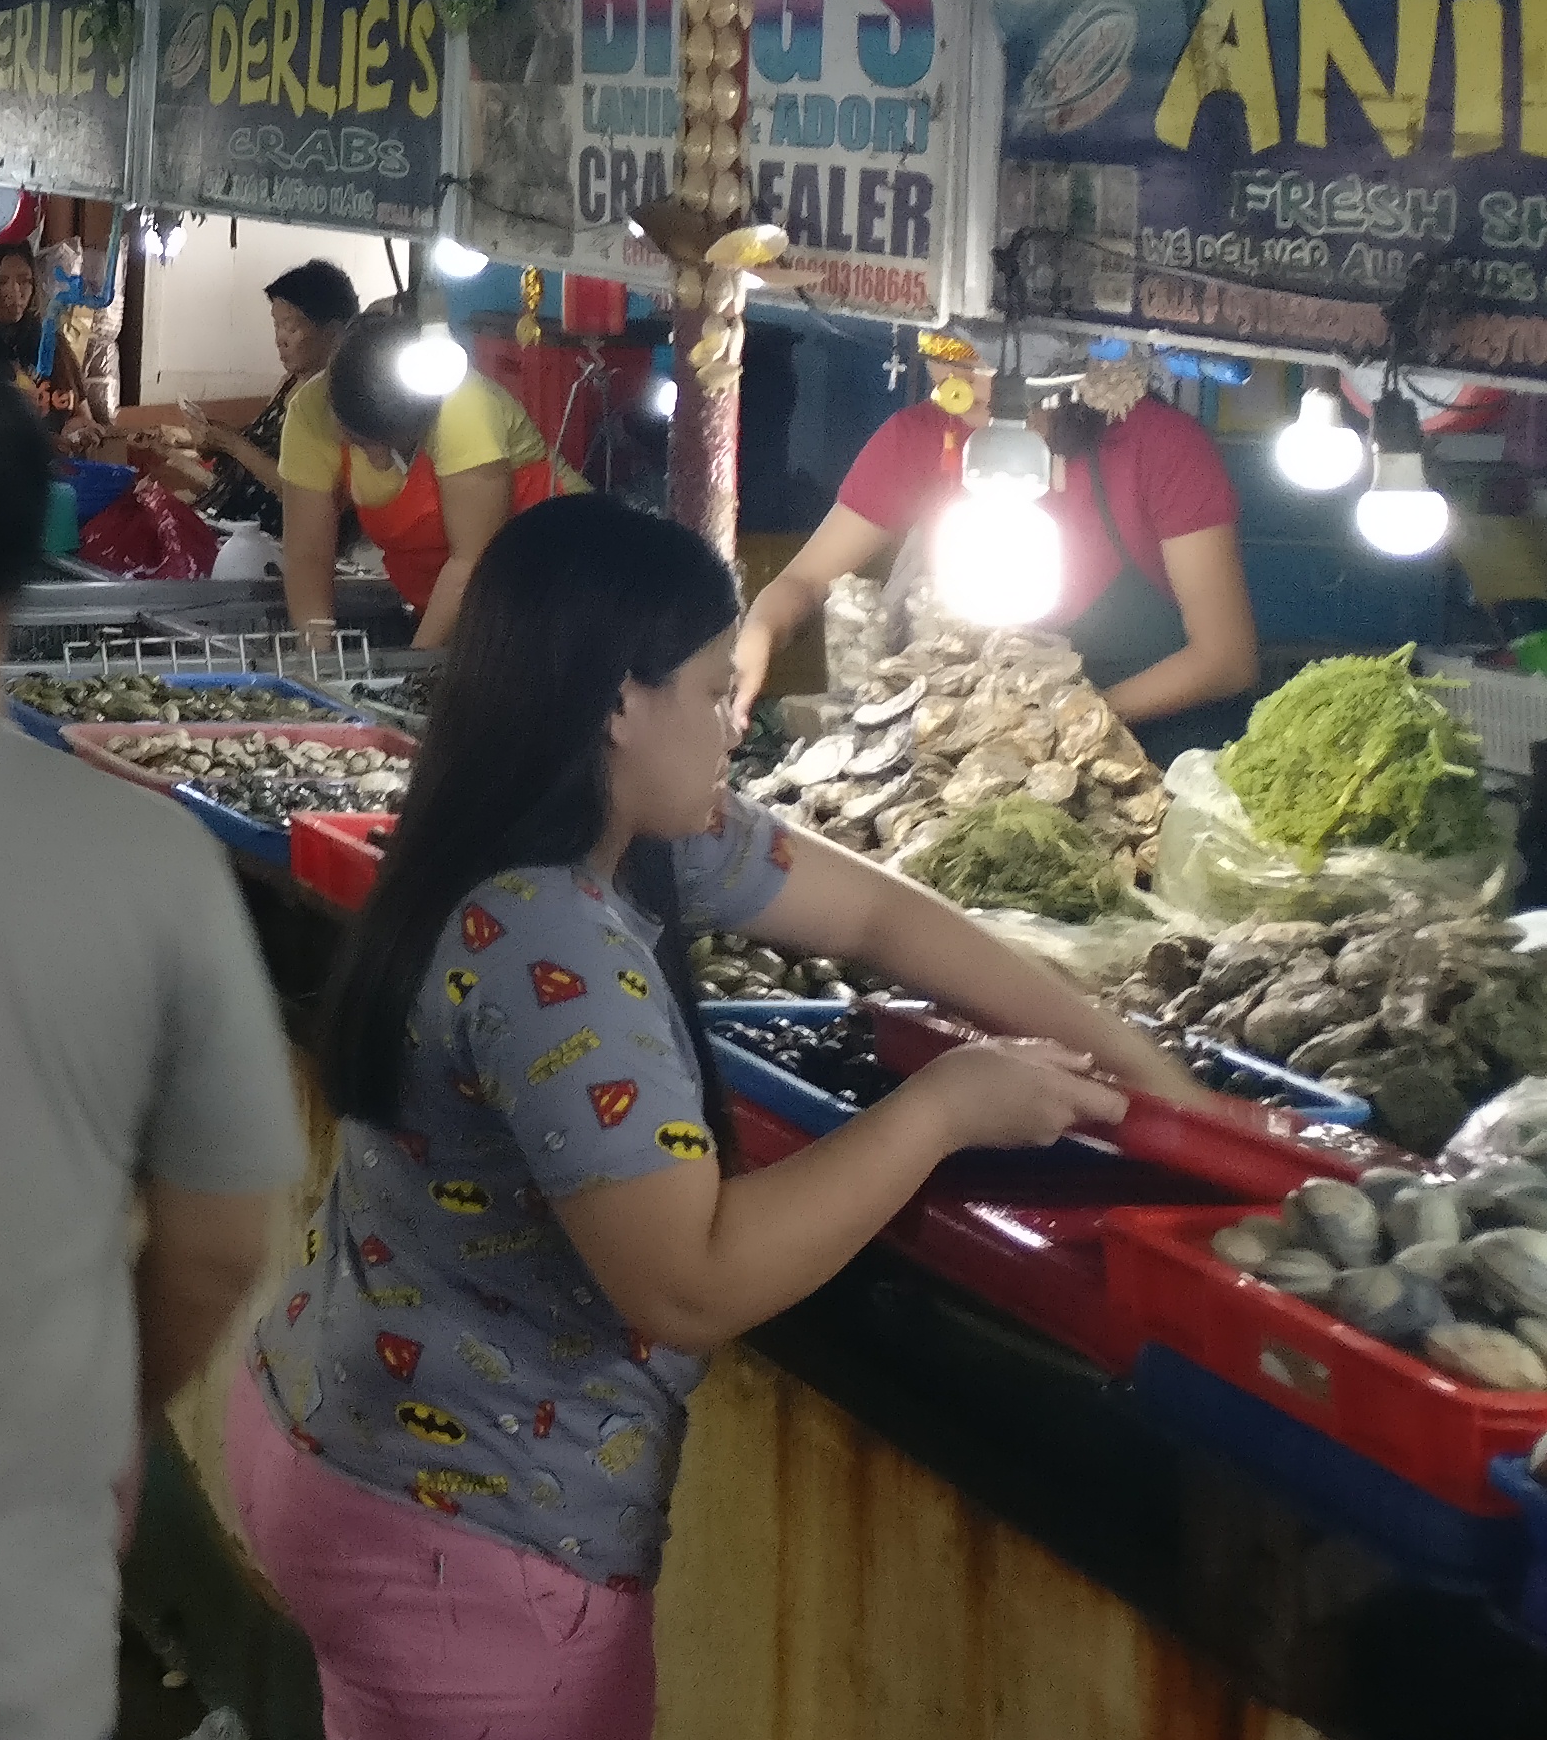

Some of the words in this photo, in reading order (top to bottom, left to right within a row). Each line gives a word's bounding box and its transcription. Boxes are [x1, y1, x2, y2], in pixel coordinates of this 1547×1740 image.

[578, 145, 669, 224] CRA
[755, 160, 933, 259] EALER
[1230, 168, 1458, 242] FRESH
